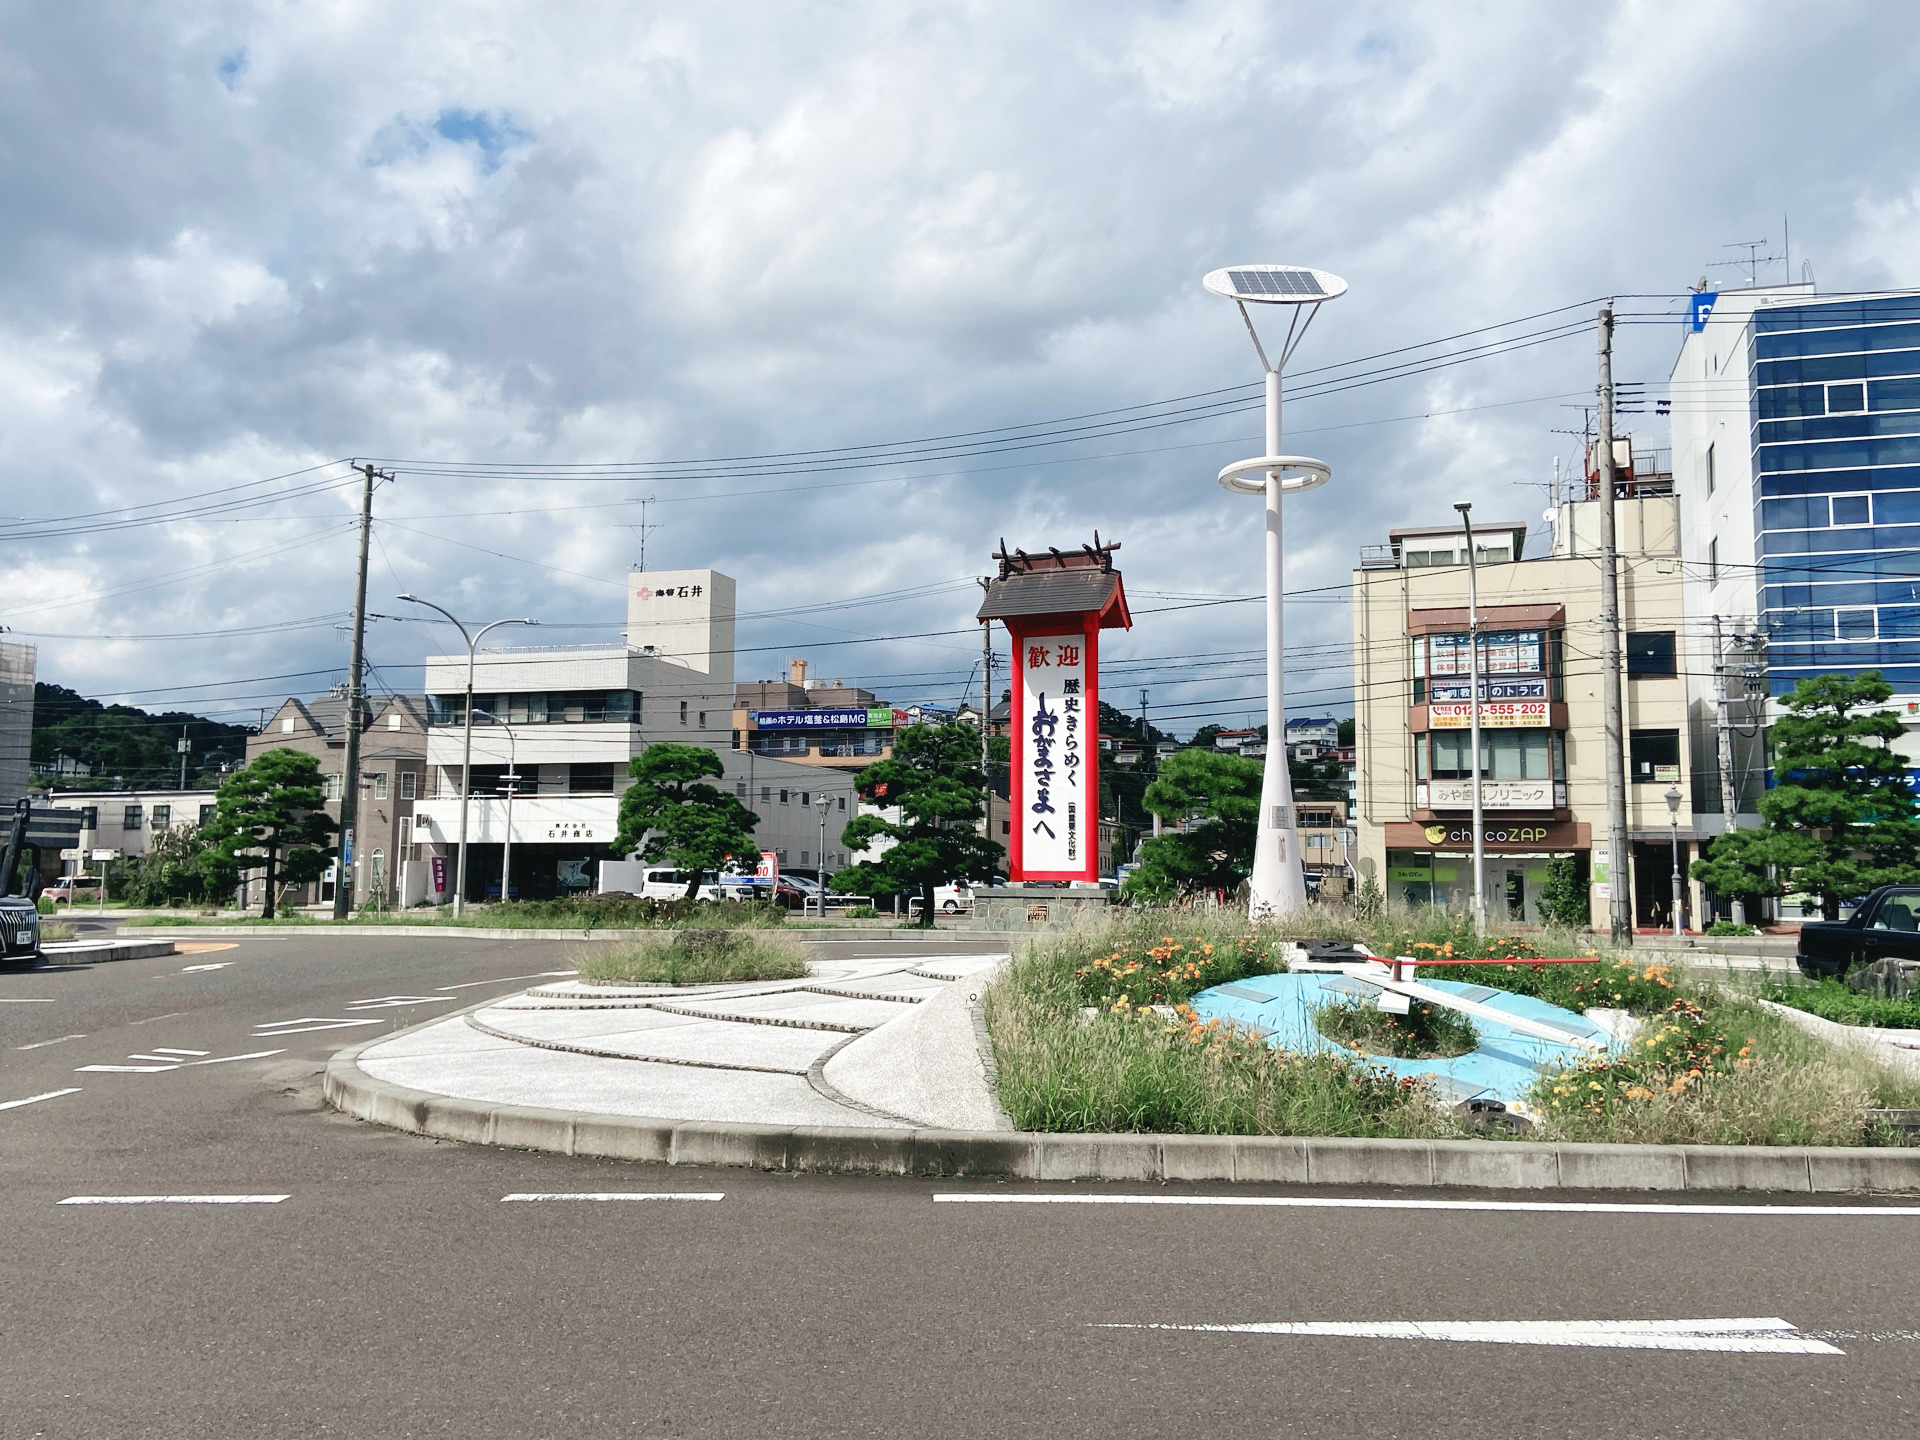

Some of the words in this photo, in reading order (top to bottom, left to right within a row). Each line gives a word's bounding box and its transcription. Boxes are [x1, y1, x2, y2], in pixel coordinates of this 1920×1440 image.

[1027, 644, 1080, 669] 歓迎
[1454, 704, 1546, 716] 0120-555-202
[1063, 678, 1081, 787] 歴史きらめく
[548, 830, 593, 838] 石井商店
[1450, 828, 1547, 842] chcoZAP
